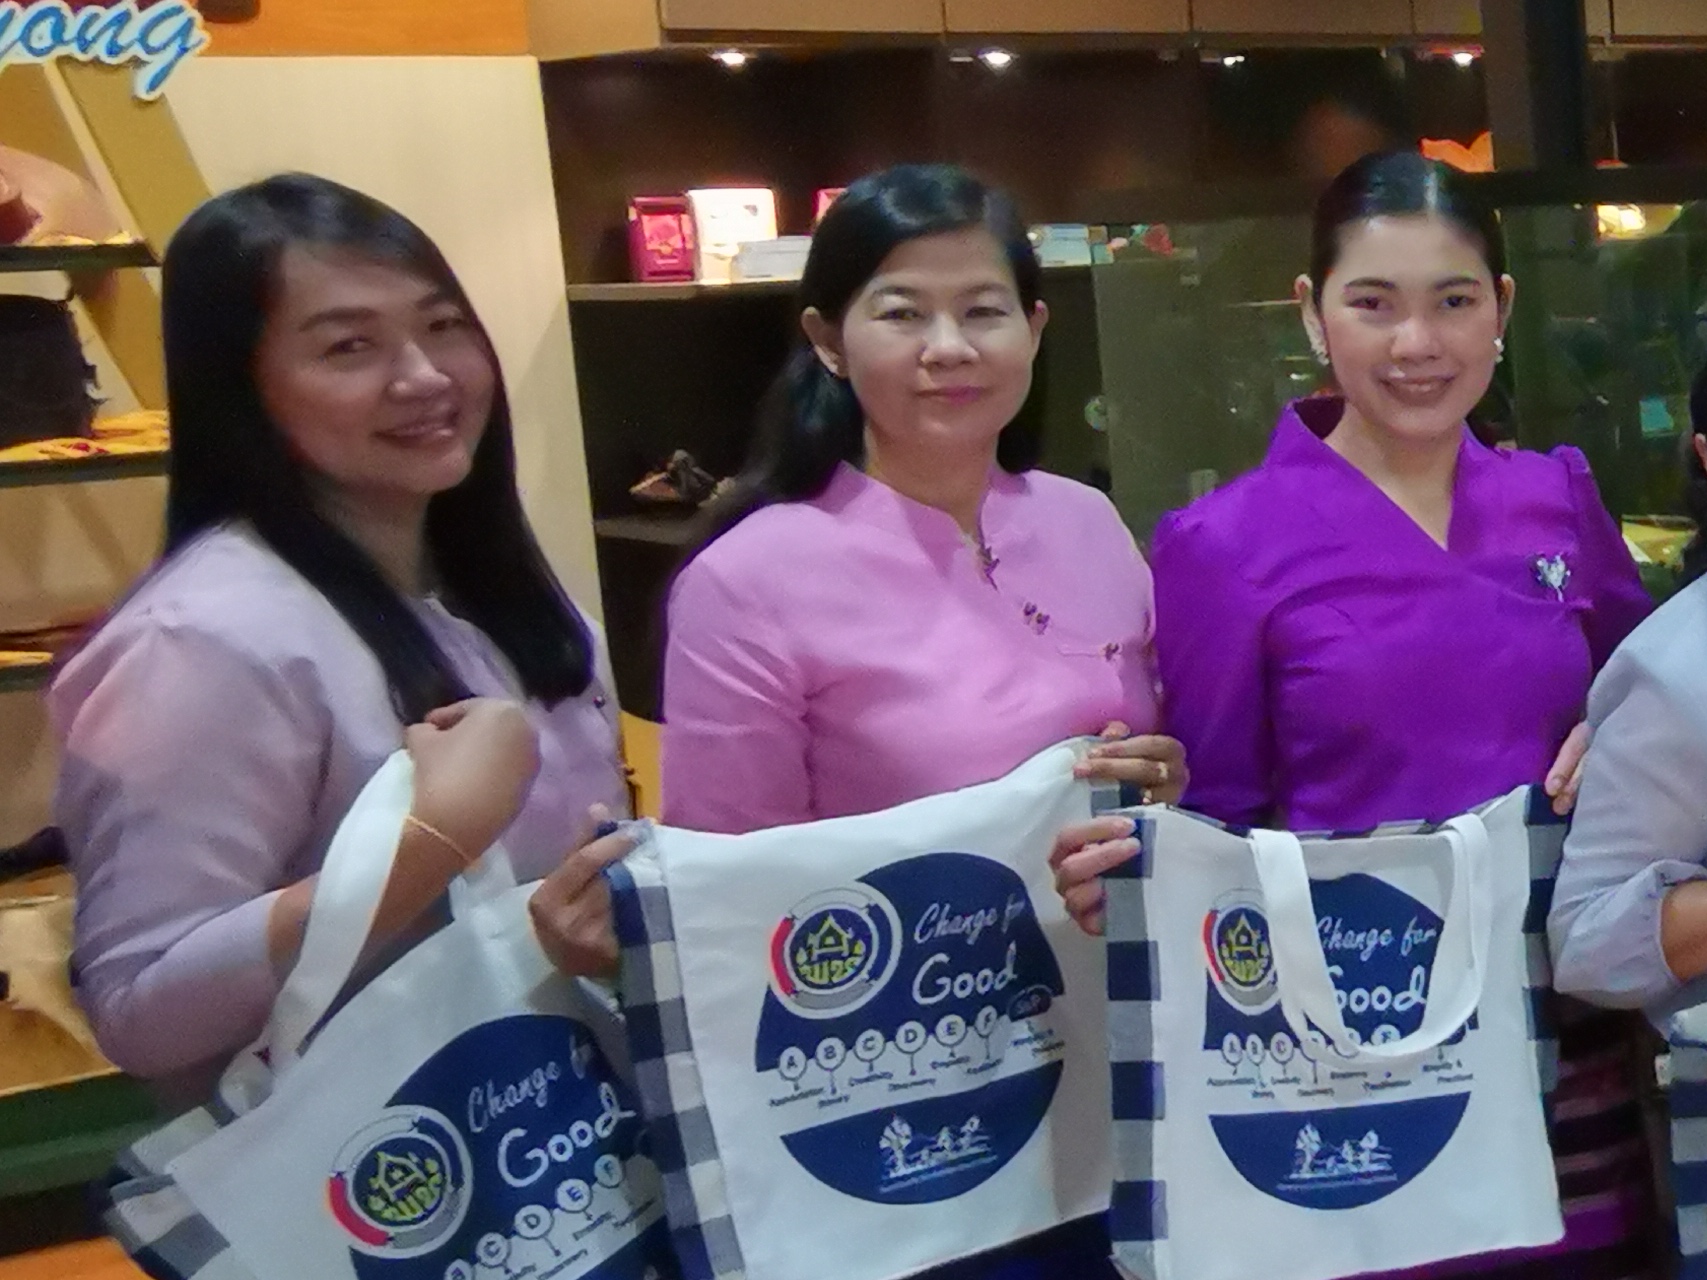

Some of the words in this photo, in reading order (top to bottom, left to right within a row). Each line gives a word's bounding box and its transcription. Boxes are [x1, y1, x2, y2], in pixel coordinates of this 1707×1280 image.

[1401, 916, 1437, 958] for
[913, 940, 1017, 1005] Good
[468, 1060, 561, 1134] Change
[498, 1081, 637, 1188] Good
